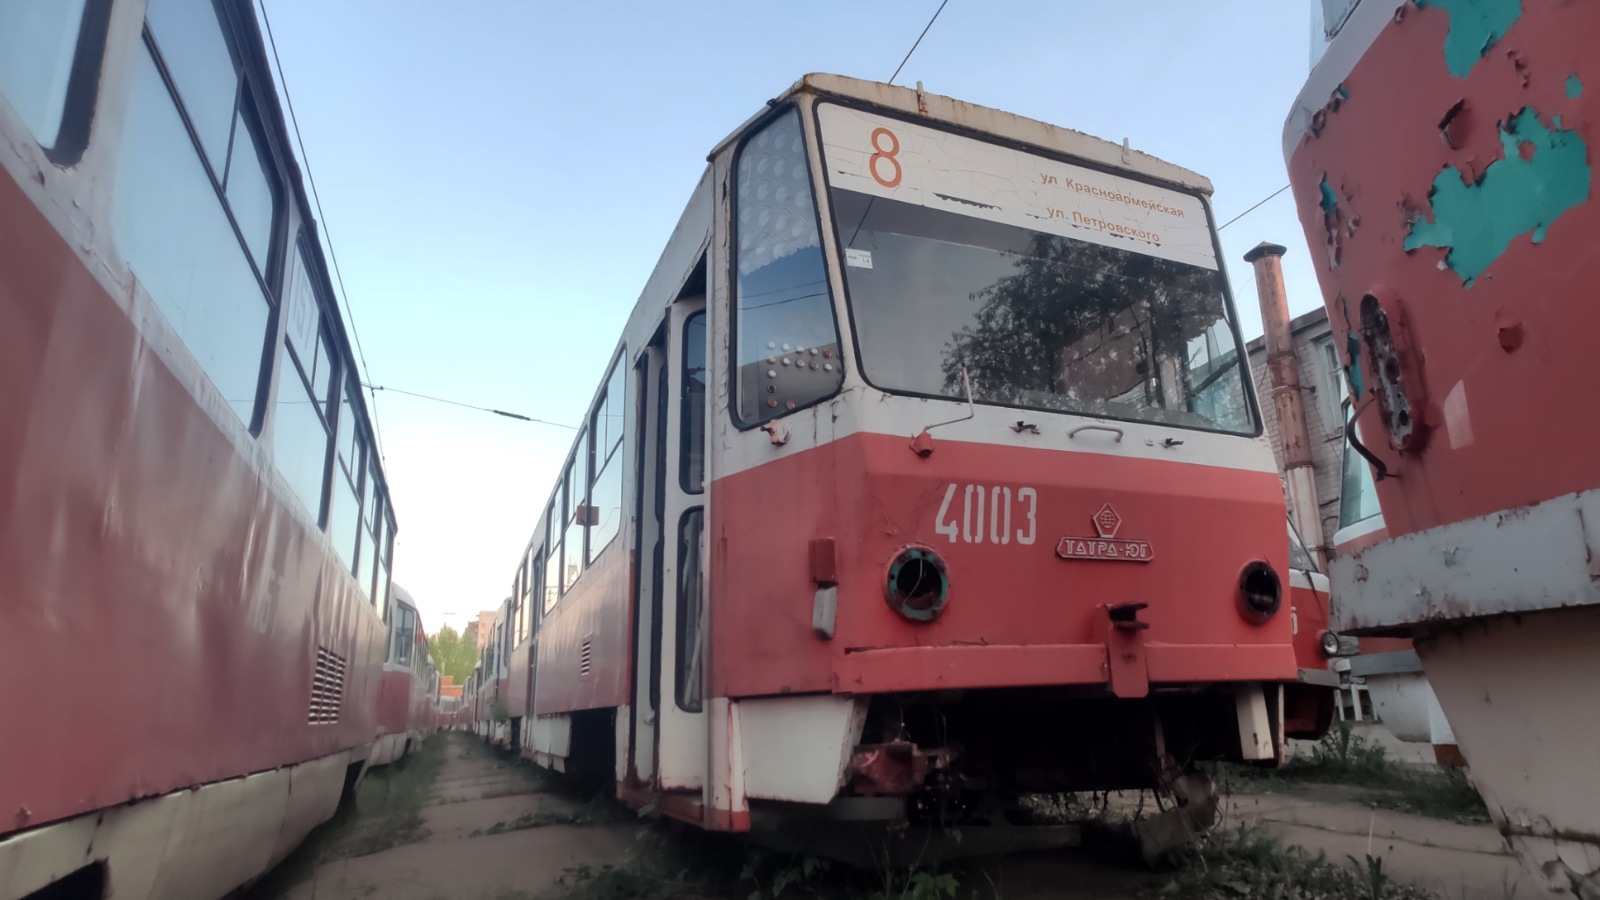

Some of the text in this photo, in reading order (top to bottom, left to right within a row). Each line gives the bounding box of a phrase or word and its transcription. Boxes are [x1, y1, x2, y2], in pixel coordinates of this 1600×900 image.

[869, 127, 902, 188] 8
[1065, 177, 1185, 218] Красноармейская
[1072, 211, 1160, 242] Петровского
[935, 483, 1037, 545] 4003
[1065, 540, 1148, 558] ТАТРА-ЮГ
